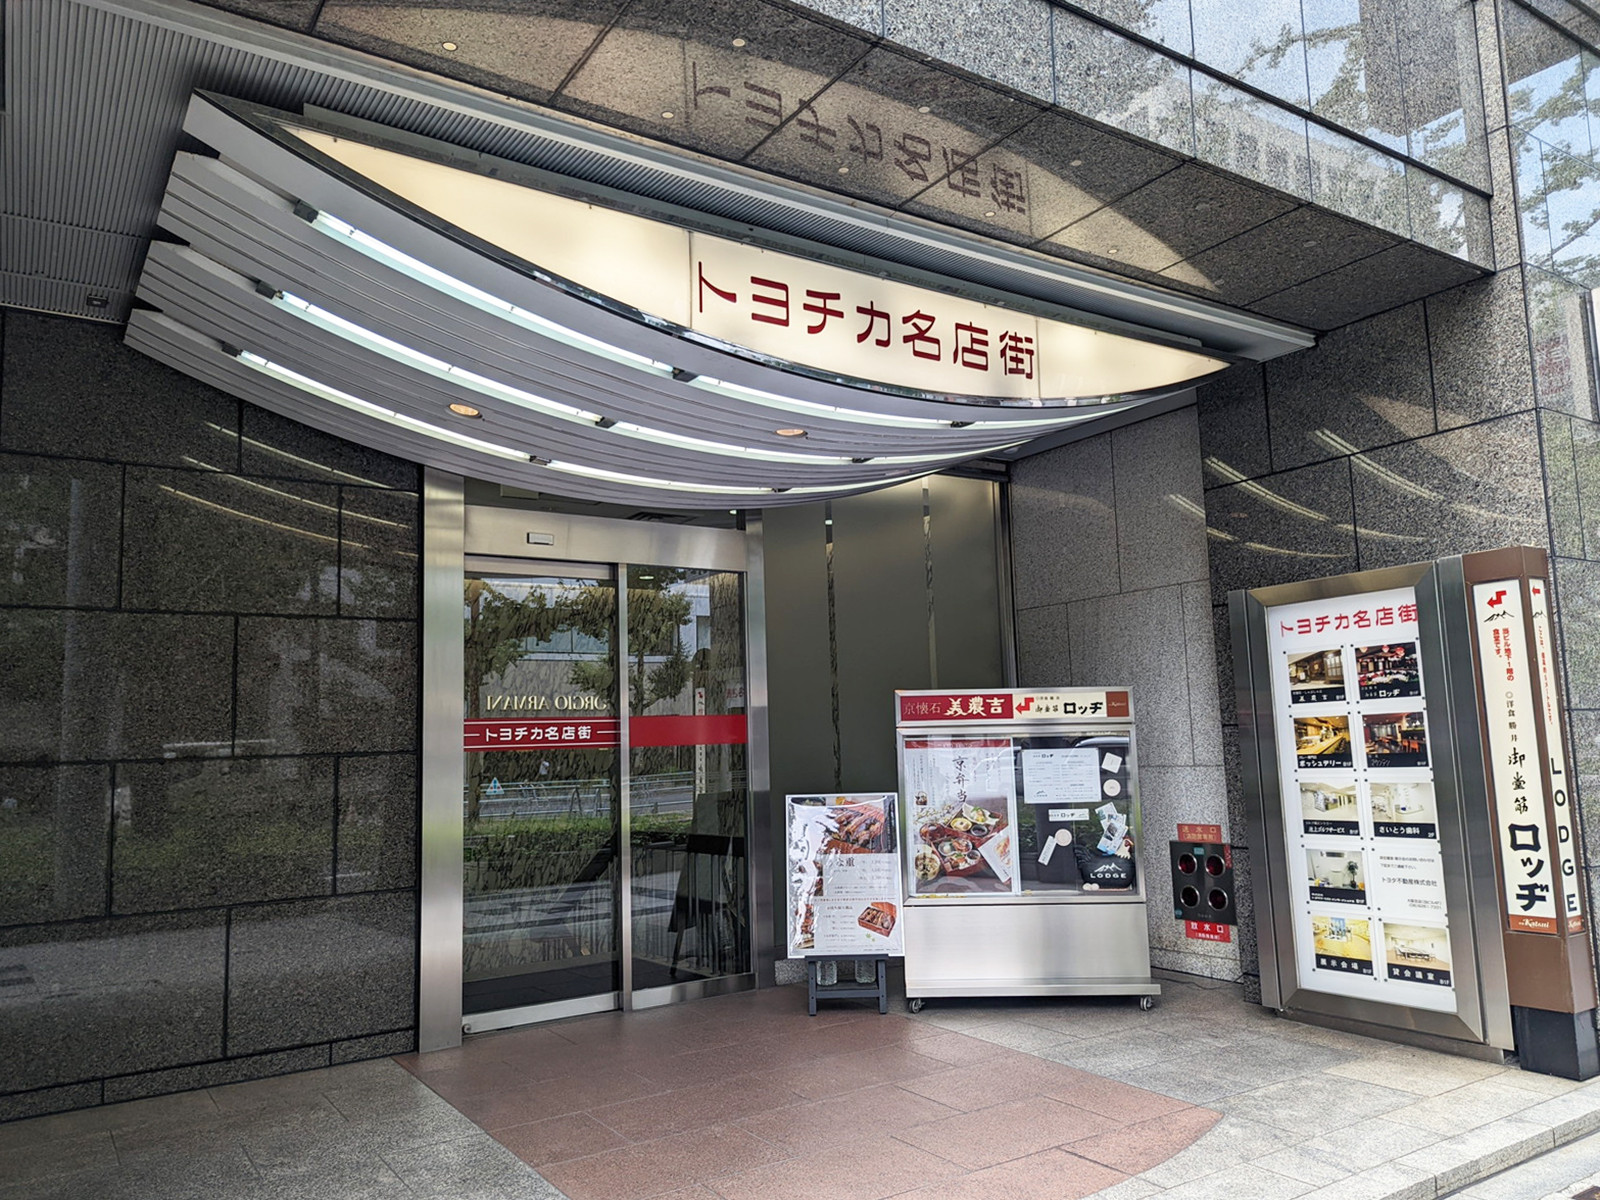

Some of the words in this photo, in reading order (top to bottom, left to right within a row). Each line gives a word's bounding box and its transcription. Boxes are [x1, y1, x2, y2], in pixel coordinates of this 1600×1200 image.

[698, 261, 1034, 380] トヨチカ名店街
[1280, 603, 1418, 637] トヨチカ名店街
[1378, 688, 1401, 698] ロッヂ
[903, 701, 942, 715] 京懐石
[944, 695, 1006, 717] 美濃吉
[1063, 701, 1103, 715] ロッヂ
[485, 725, 592, 742] トヨチカ名店街
[1508, 747, 1529, 815] 御堂筋
[1379, 826, 1420, 835] さいとう歯科
[1550, 757, 1578, 912] LODGE
[1508, 823, 1550, 912] ロッヂ
[1382, 876, 1437, 887] トヨタ不動産株式会社
[1320, 957, 1359, 970] 展示会場
[1392, 967, 1435, 981] 貸会議室
